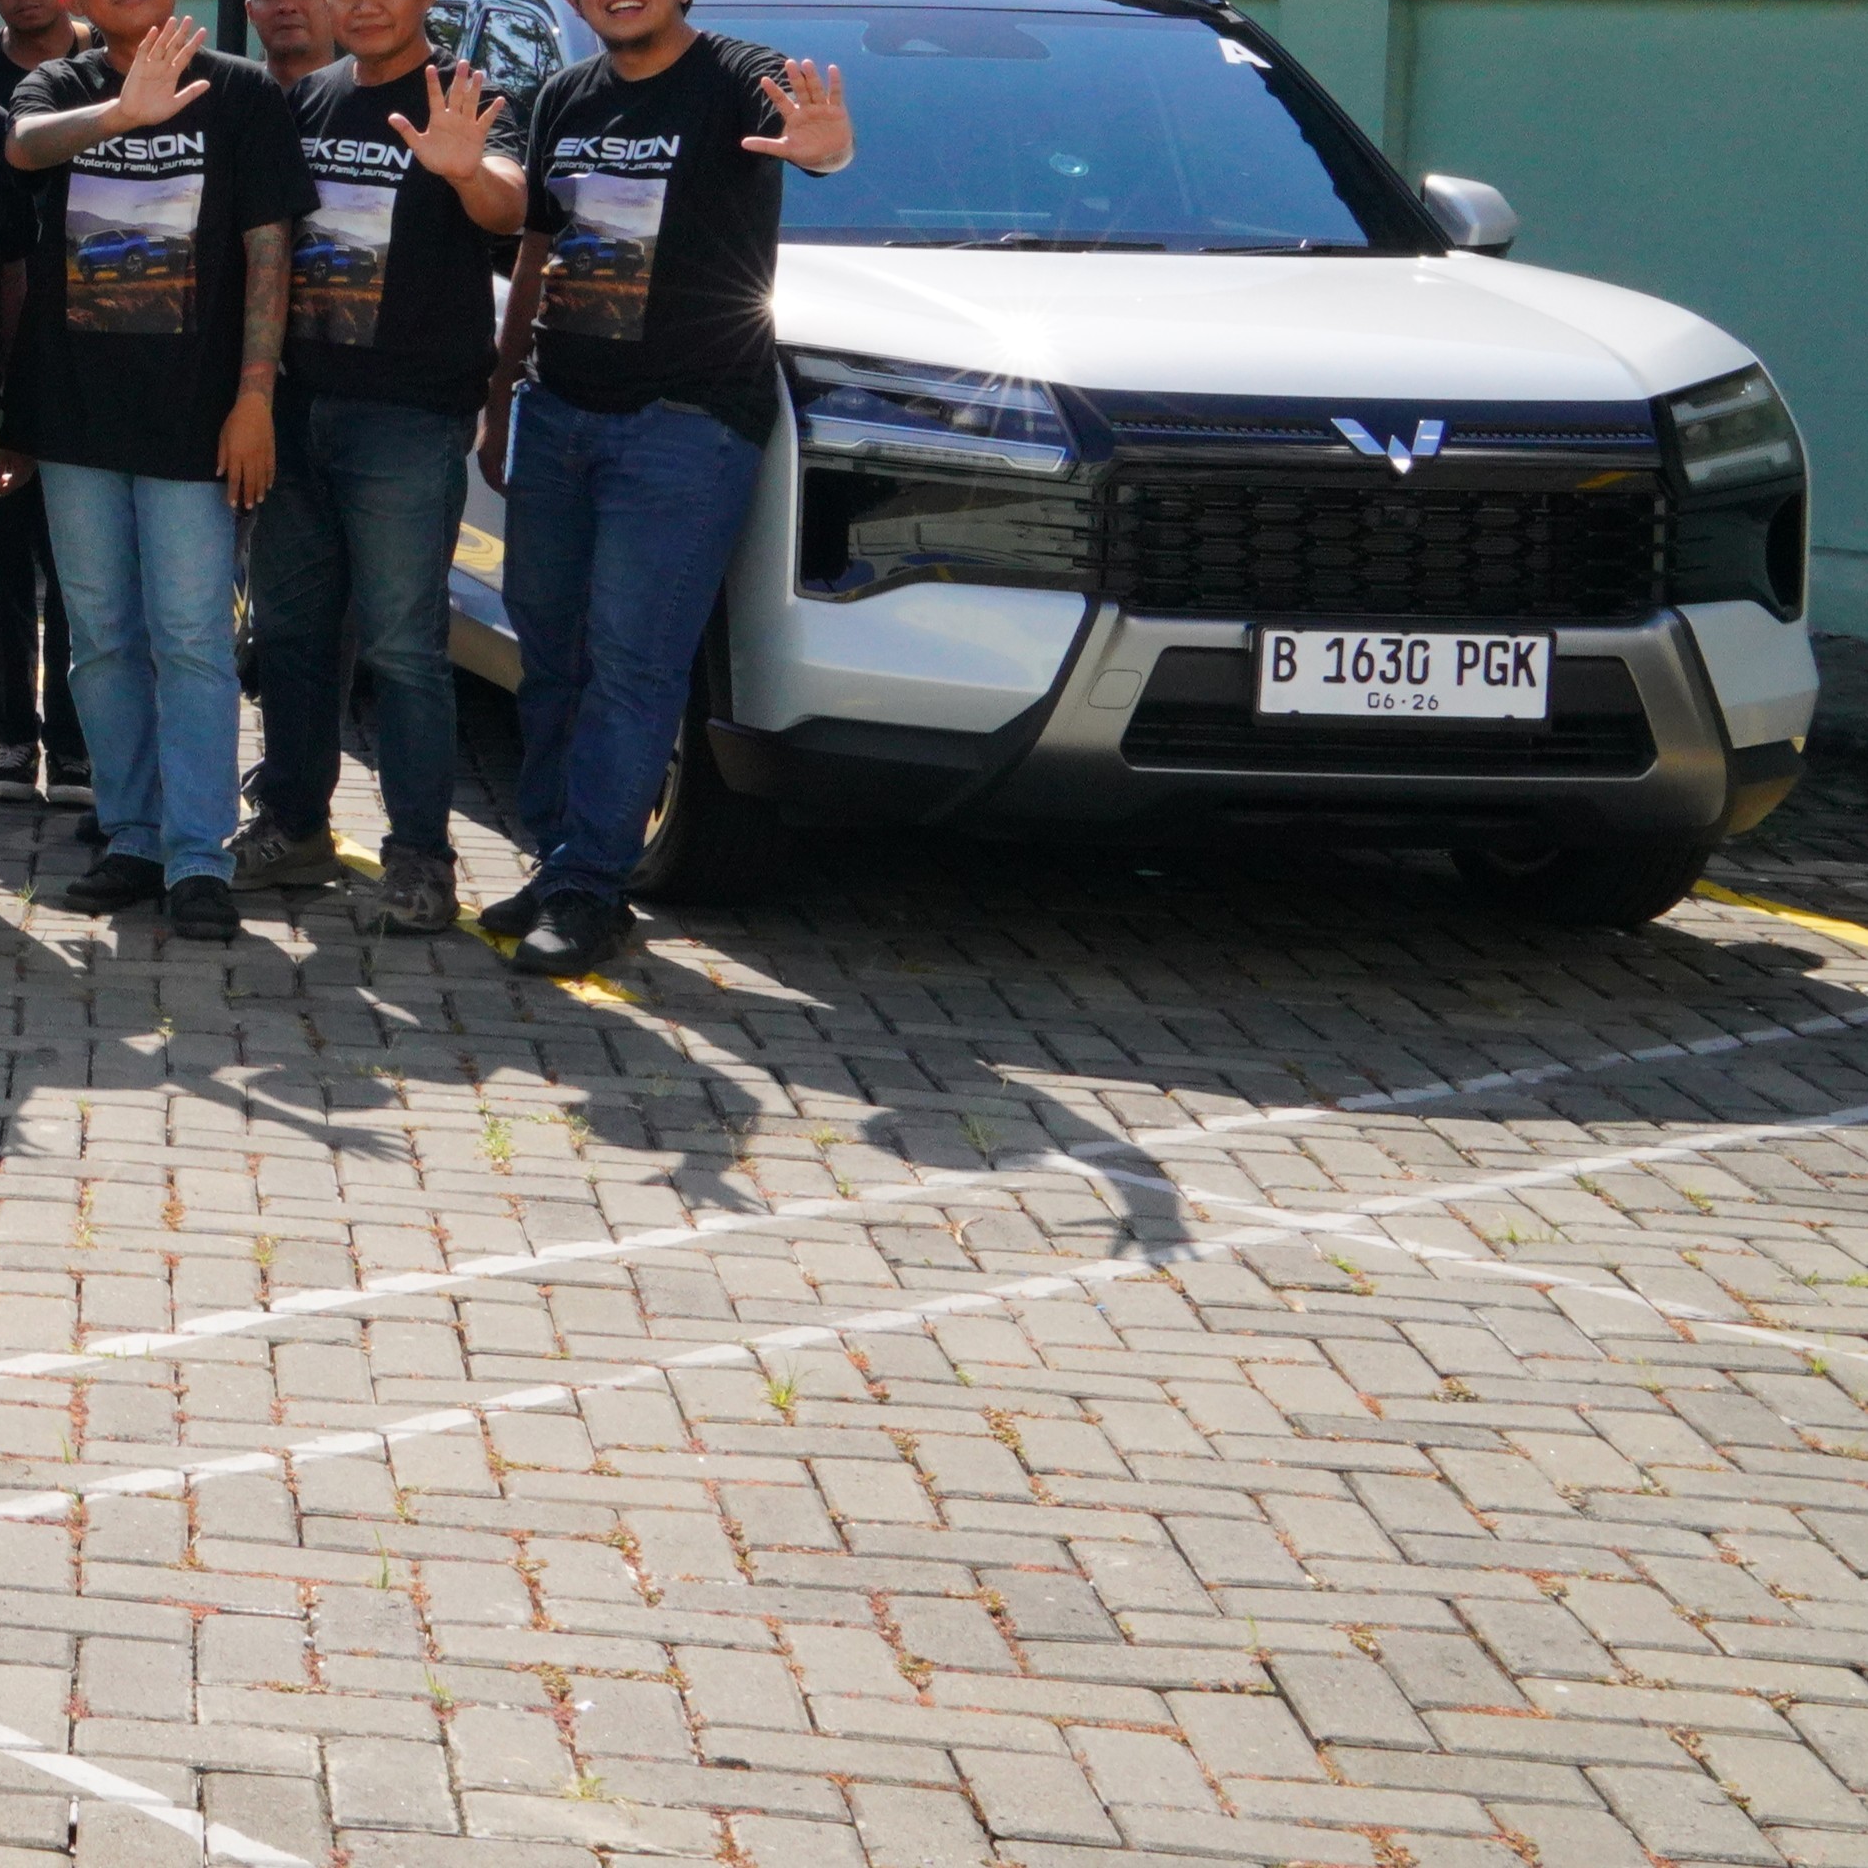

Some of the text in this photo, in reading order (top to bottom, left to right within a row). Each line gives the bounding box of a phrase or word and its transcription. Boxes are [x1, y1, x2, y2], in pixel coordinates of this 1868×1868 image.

[1218, 37, 1273, 69] A
[554, 135, 680, 161] EKSION
[73, 155, 204, 174] Exploring Family Journeys
[330, 163, 359, 177] Family
[360, 166, 404, 181] Journeys
[555, 160, 595, 172] xploring
[1272, 636, 1537, 687] B 1630 PGK
